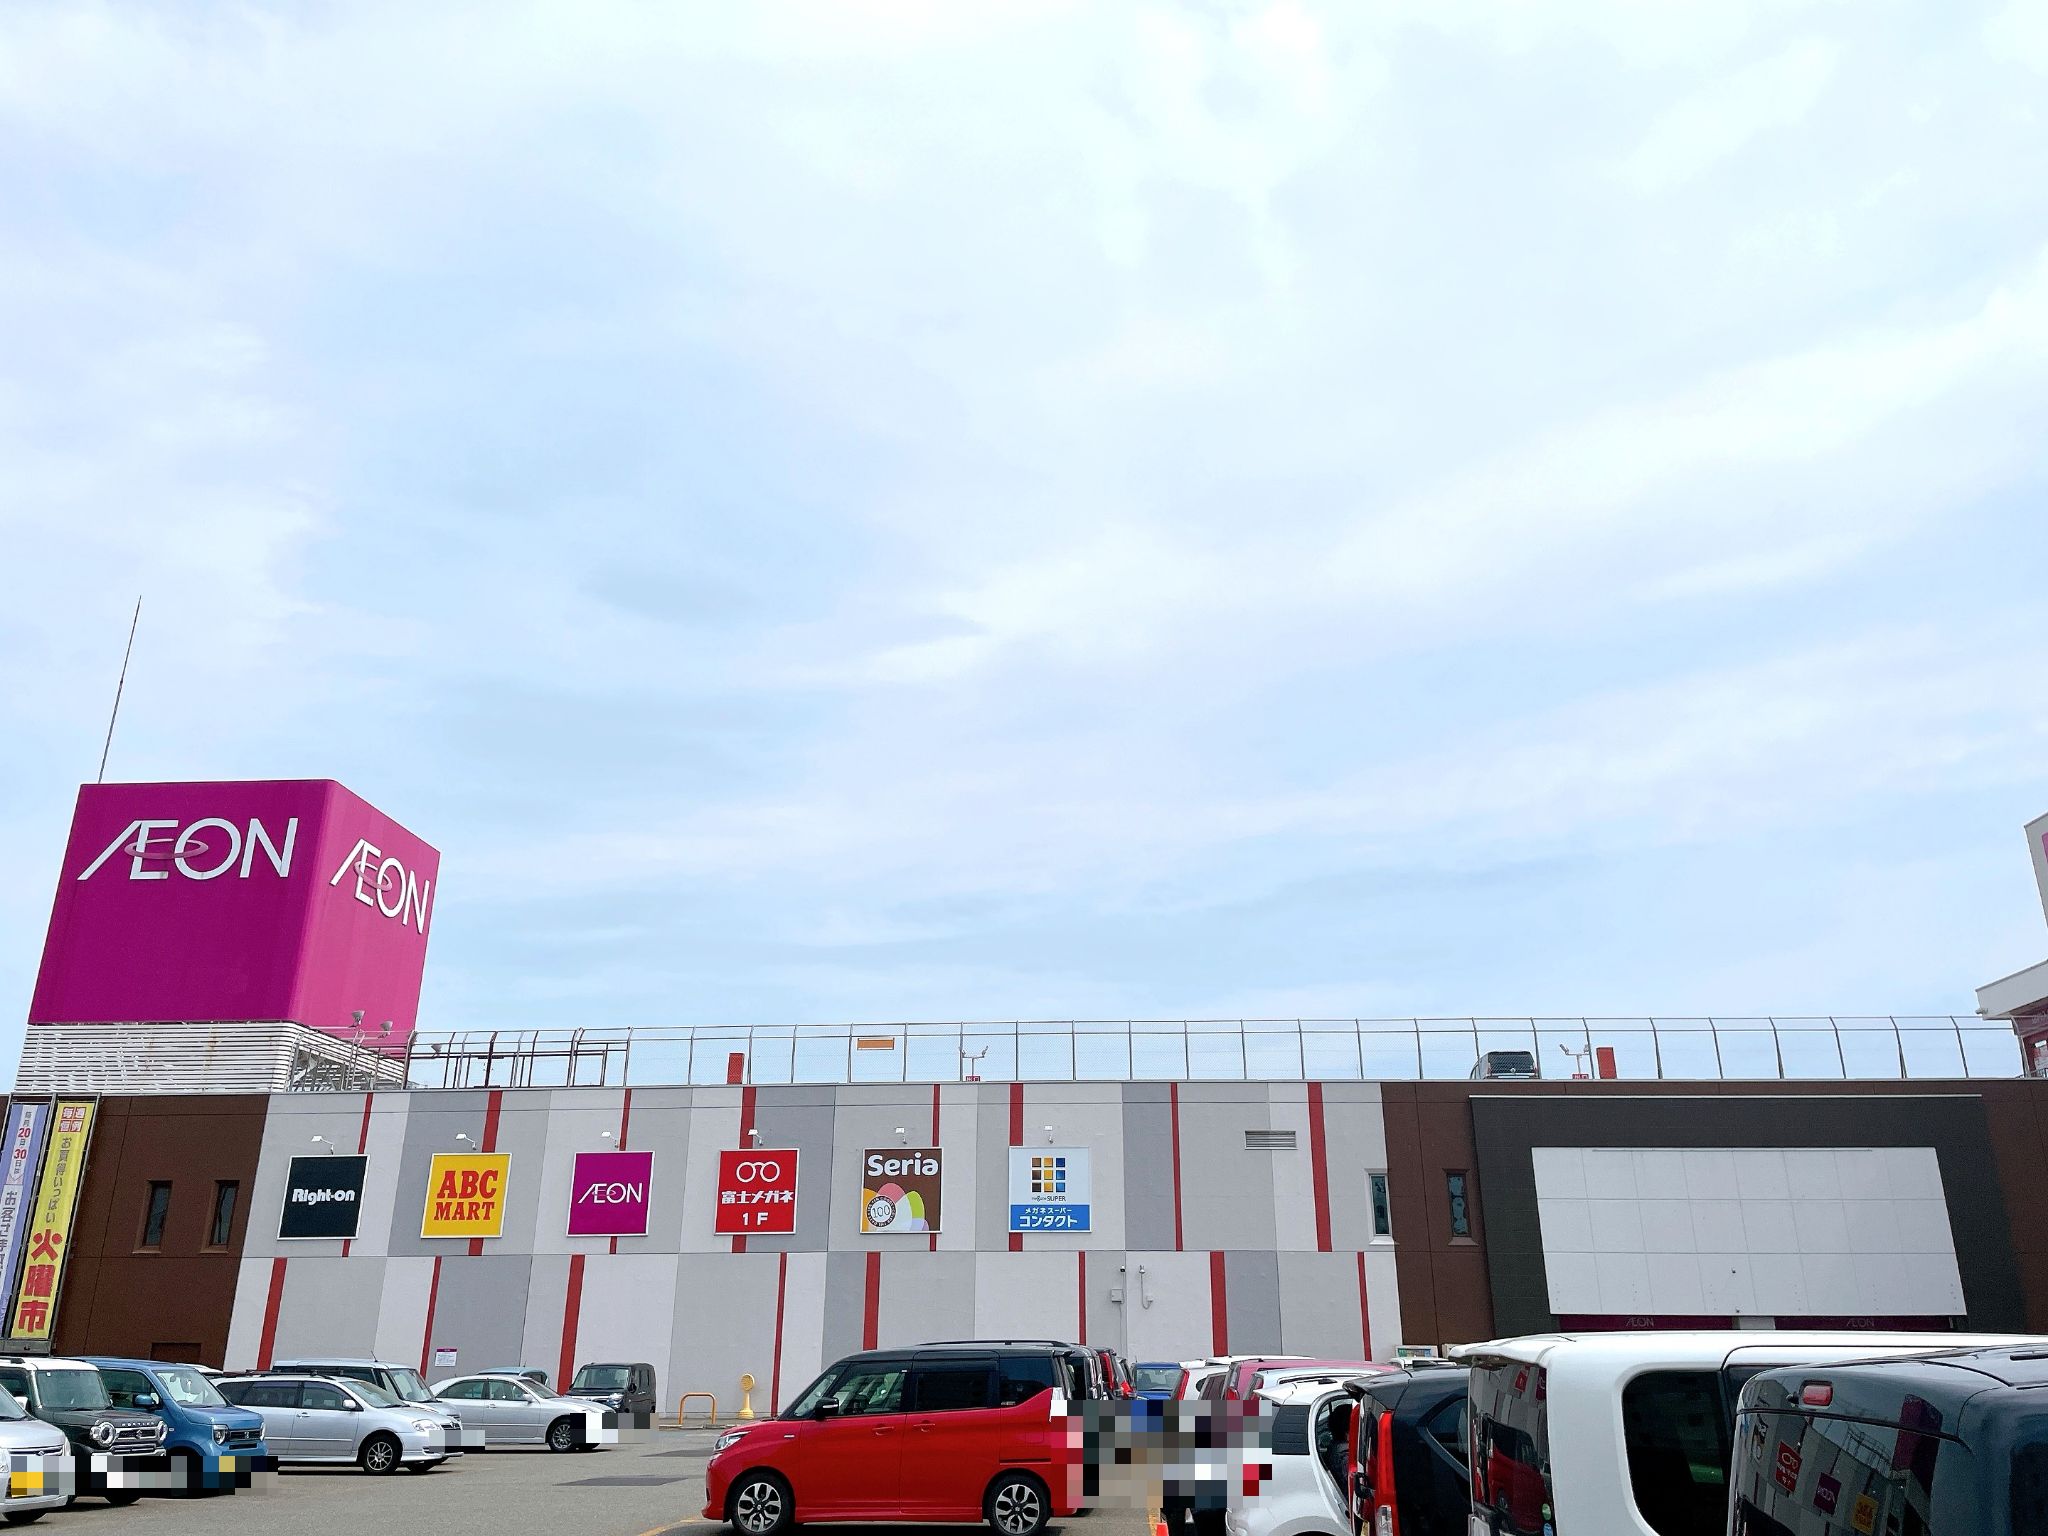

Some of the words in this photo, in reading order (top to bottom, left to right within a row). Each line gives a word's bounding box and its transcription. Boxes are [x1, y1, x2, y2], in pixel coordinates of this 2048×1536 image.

[867, 1152, 939, 1176] Seria
[437, 1170, 499, 1199] ABC
[291, 1188, 355, 1205] Right-on
[721, 1190, 795, 1204] 富士メガネ
[434, 1201, 495, 1221] MART
[872, 1205, 891, 1219] 100
[1025, 1207, 1073, 1215] メガネスーパー
[1019, 1215, 1078, 1228] コンタクト
[18, 1228, 63, 1333] 火曜市
